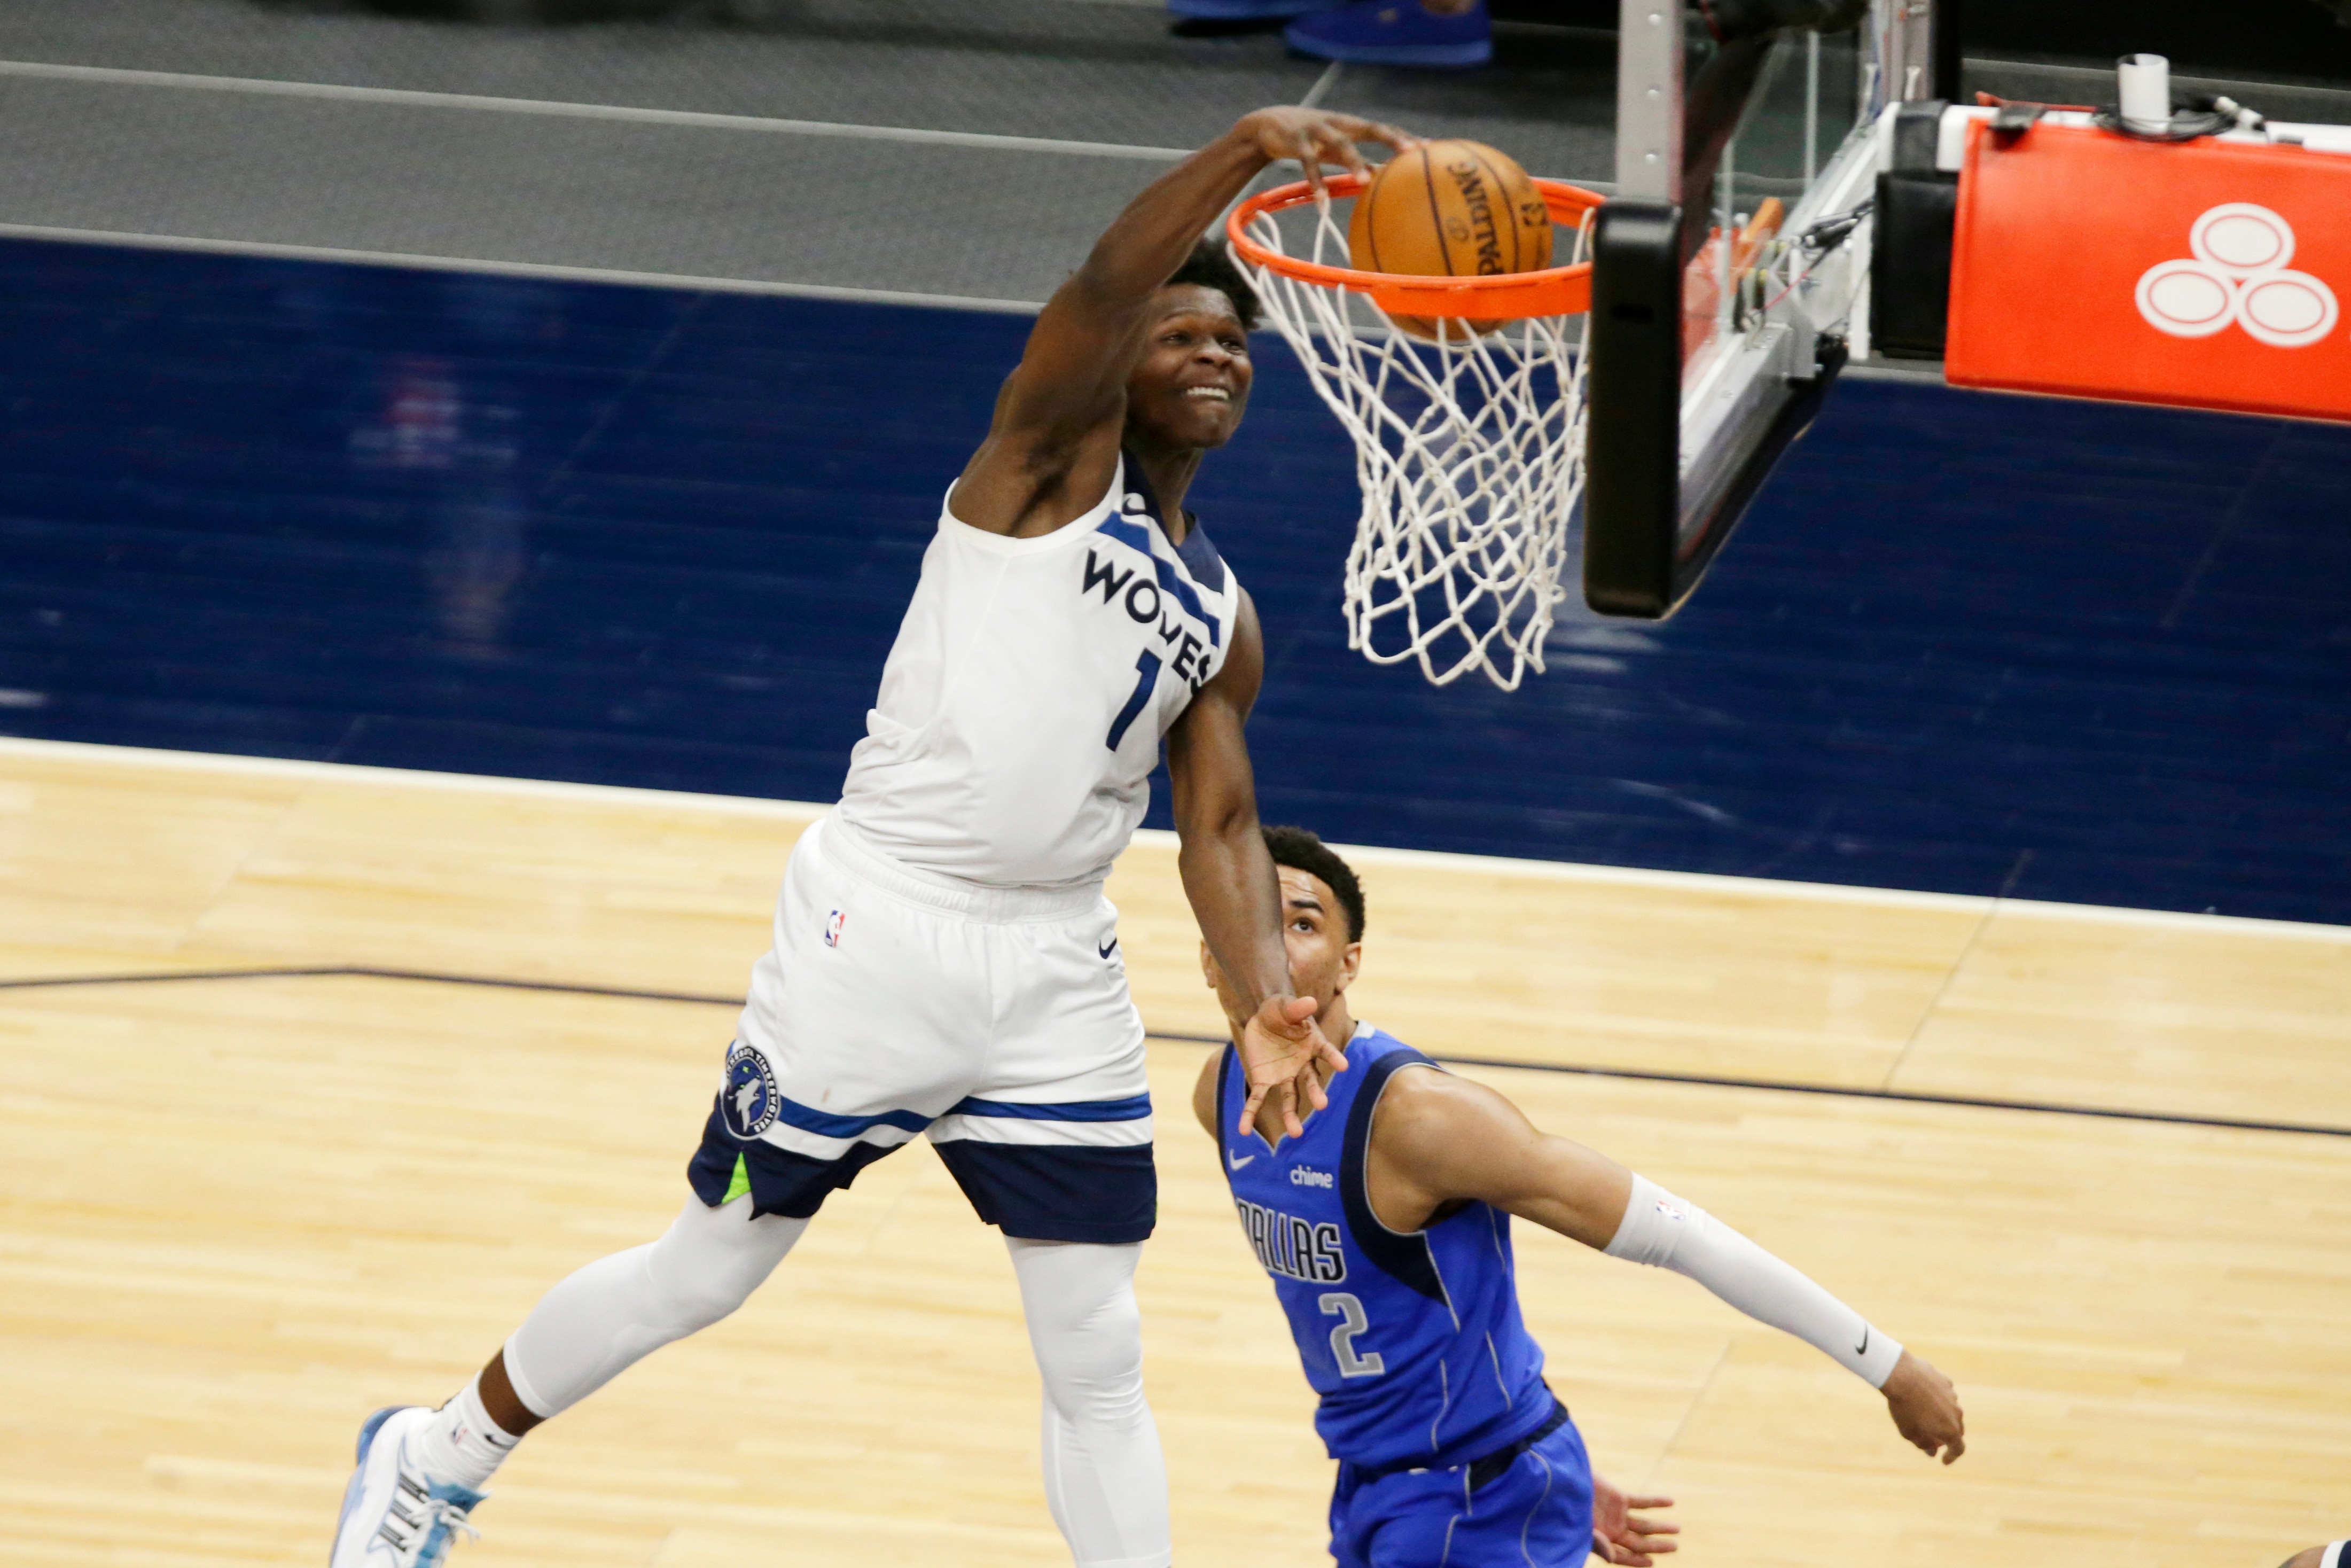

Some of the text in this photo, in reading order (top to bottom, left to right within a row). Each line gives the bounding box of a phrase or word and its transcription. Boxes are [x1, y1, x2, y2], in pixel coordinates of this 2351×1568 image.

[1447, 161, 1505, 276] PALDING
[1105, 647, 1163, 753] 1
[1290, 1164, 1333, 1189] chime
[1236, 1197, 1348, 1284] DALLAS
[1317, 1291, 1386, 1379] 2
